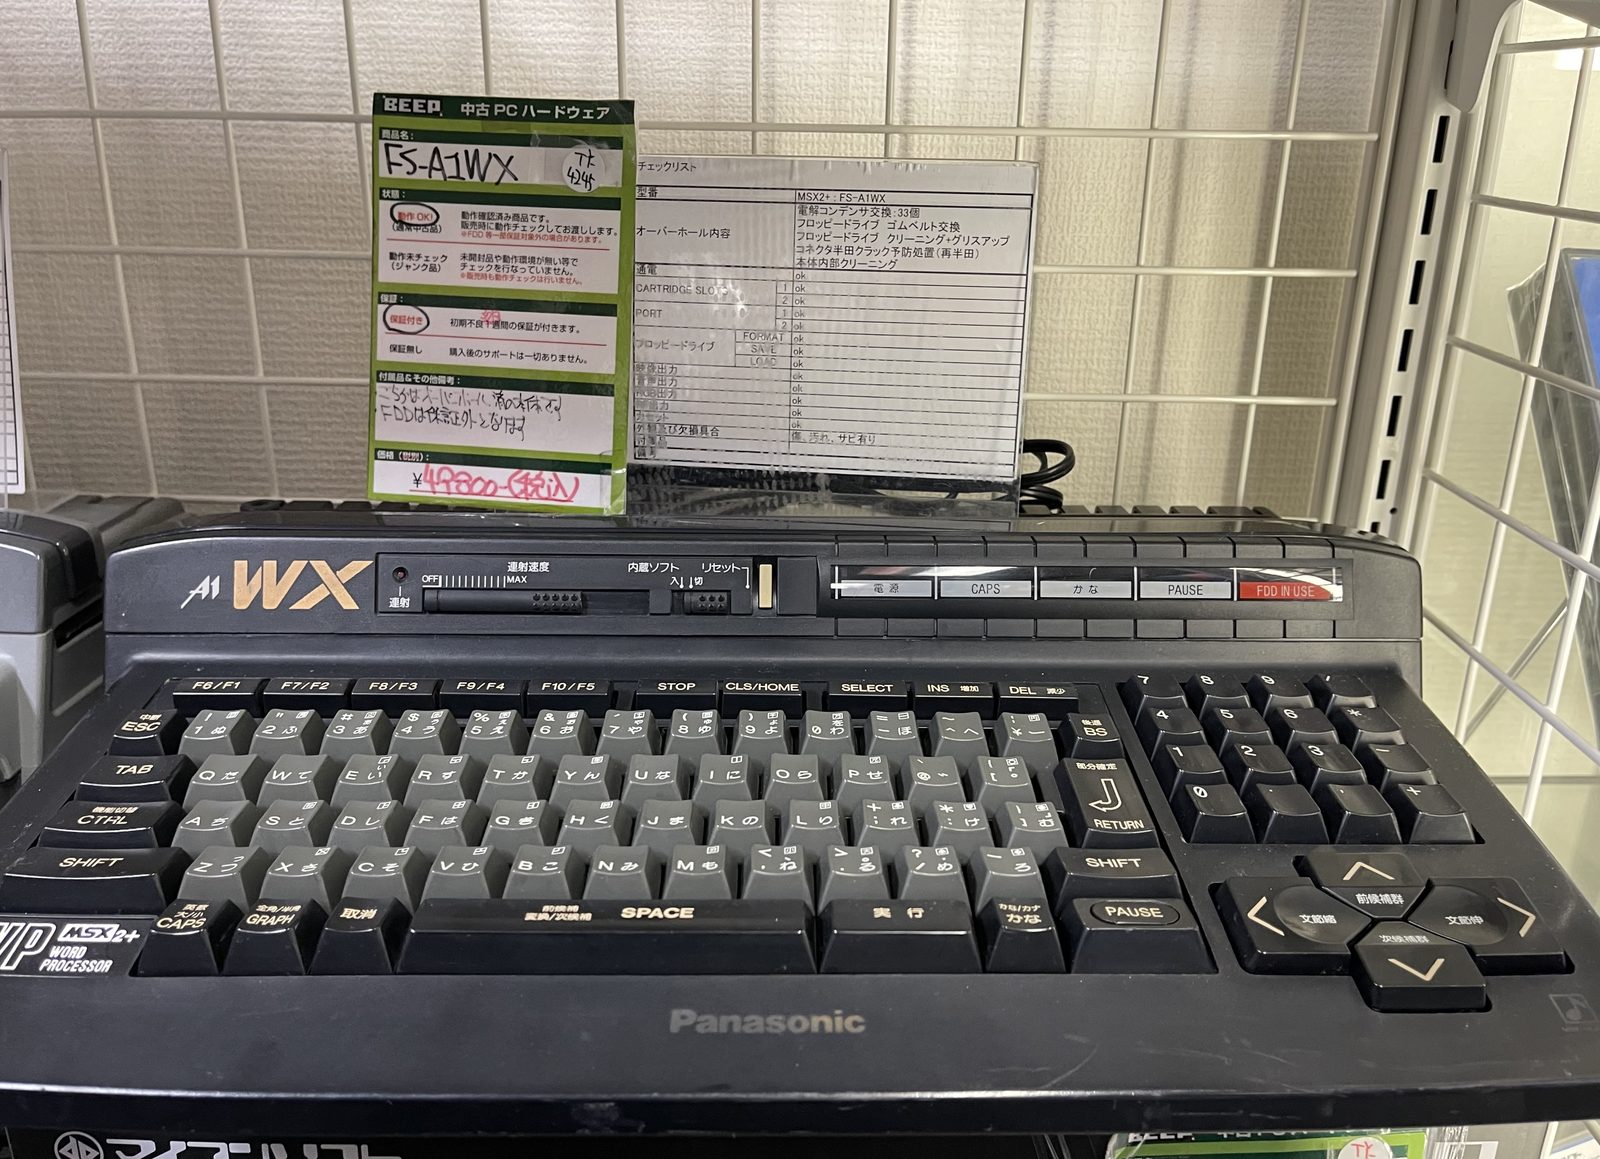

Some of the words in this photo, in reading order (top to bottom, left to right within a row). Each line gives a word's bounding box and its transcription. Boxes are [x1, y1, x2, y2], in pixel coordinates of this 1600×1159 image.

[384, 143, 518, 185] FS-A1WX
[638, 161, 697, 173] チェックリスト
[637, 186, 658, 198] 型番
[839, 193, 886, 203] FS-A1WX
[797, 219, 880, 233] フロッピードライブ
[636, 226, 731, 239] オーバーホール内容
[796, 231, 879, 244] フロッピードライブ
[796, 256, 898, 270] 本体内部クリーニング
[743, 331, 786, 342] FORMAT
[627, 562, 680, 573] 内蔵ソフト
[701, 562, 741, 573] リセット
[421, 574, 440, 583] OFF
[506, 575, 528, 584] MAX
[233, 560, 374, 610] WX
[970, 584, 1001, 596] CAPS
[1167, 584, 1204, 596] PAUSE
[1256, 585, 1278, 598] FDD
[1281, 586, 1290, 598] IN
[1292, 586, 1315, 599] USE
[192, 680, 241, 690] F6/F1
[281, 681, 330, 691] F7/F2
[368, 682, 418, 691] F8/F3
[456, 682, 505, 691] F9/F4
[541, 682, 596, 691] F10/F5
[657, 682, 696, 691] STOP
[725, 682, 800, 693] CLS/HOME
[841, 683, 894, 693] SELECT
[927, 684, 950, 693] INS
[1009, 686, 1037, 695] DEL
[121, 721, 161, 732] ESC
[1084, 726, 1108, 737] BS
[115, 764, 154, 775] TAB
[77, 815, 128, 825] CTRL
[1094, 818, 1145, 830] RETURN
[59, 857, 124, 868] SHIFT
[1085, 857, 1142, 869] SHIFT
[621, 907, 695, 919] SPACE
[1105, 906, 1164, 918] PAUSE
[156, 917, 207, 930] CAPS
[246, 913, 296, 926] GRAPH
[48, 945, 88, 959] WORD
[39, 959, 114, 973] PROCESSOR
[669, 1009, 867, 1034] Panasonic
